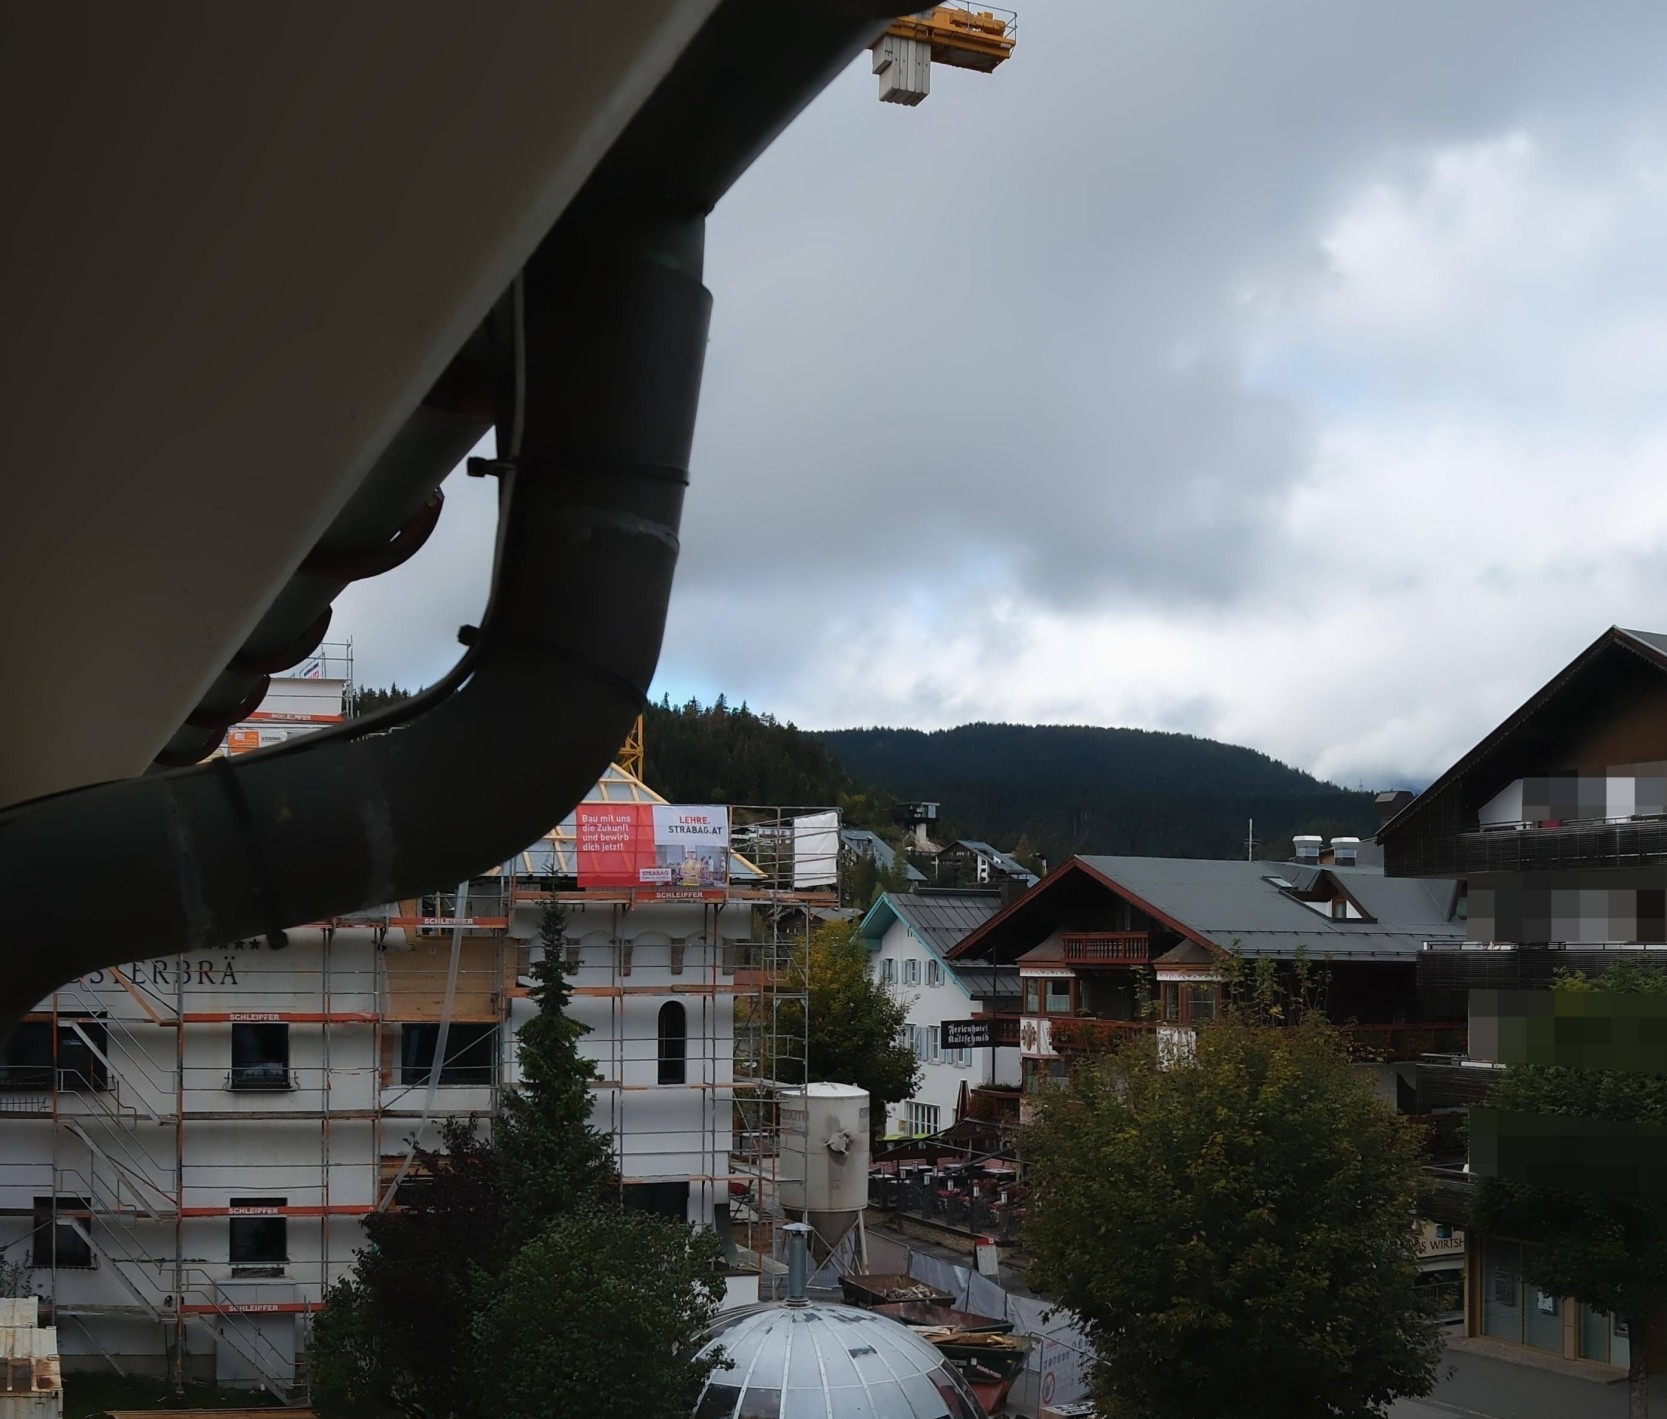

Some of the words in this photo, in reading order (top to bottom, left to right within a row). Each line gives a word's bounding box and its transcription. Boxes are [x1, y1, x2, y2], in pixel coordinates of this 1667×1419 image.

[582, 814, 598, 823] Bau
[600, 814, 613, 823] mit
[679, 816, 710, 825] LEHRE.
[582, 824, 595, 832] die
[597, 824, 629, 832] Zukunft
[668, 825, 722, 835] STRABAG.AT
[600, 833, 629, 841] bewirb
[582, 843, 599, 851] dich
[602, 842, 623, 852] jetzt!
[69, 956, 239, 985] SERBRÄ
